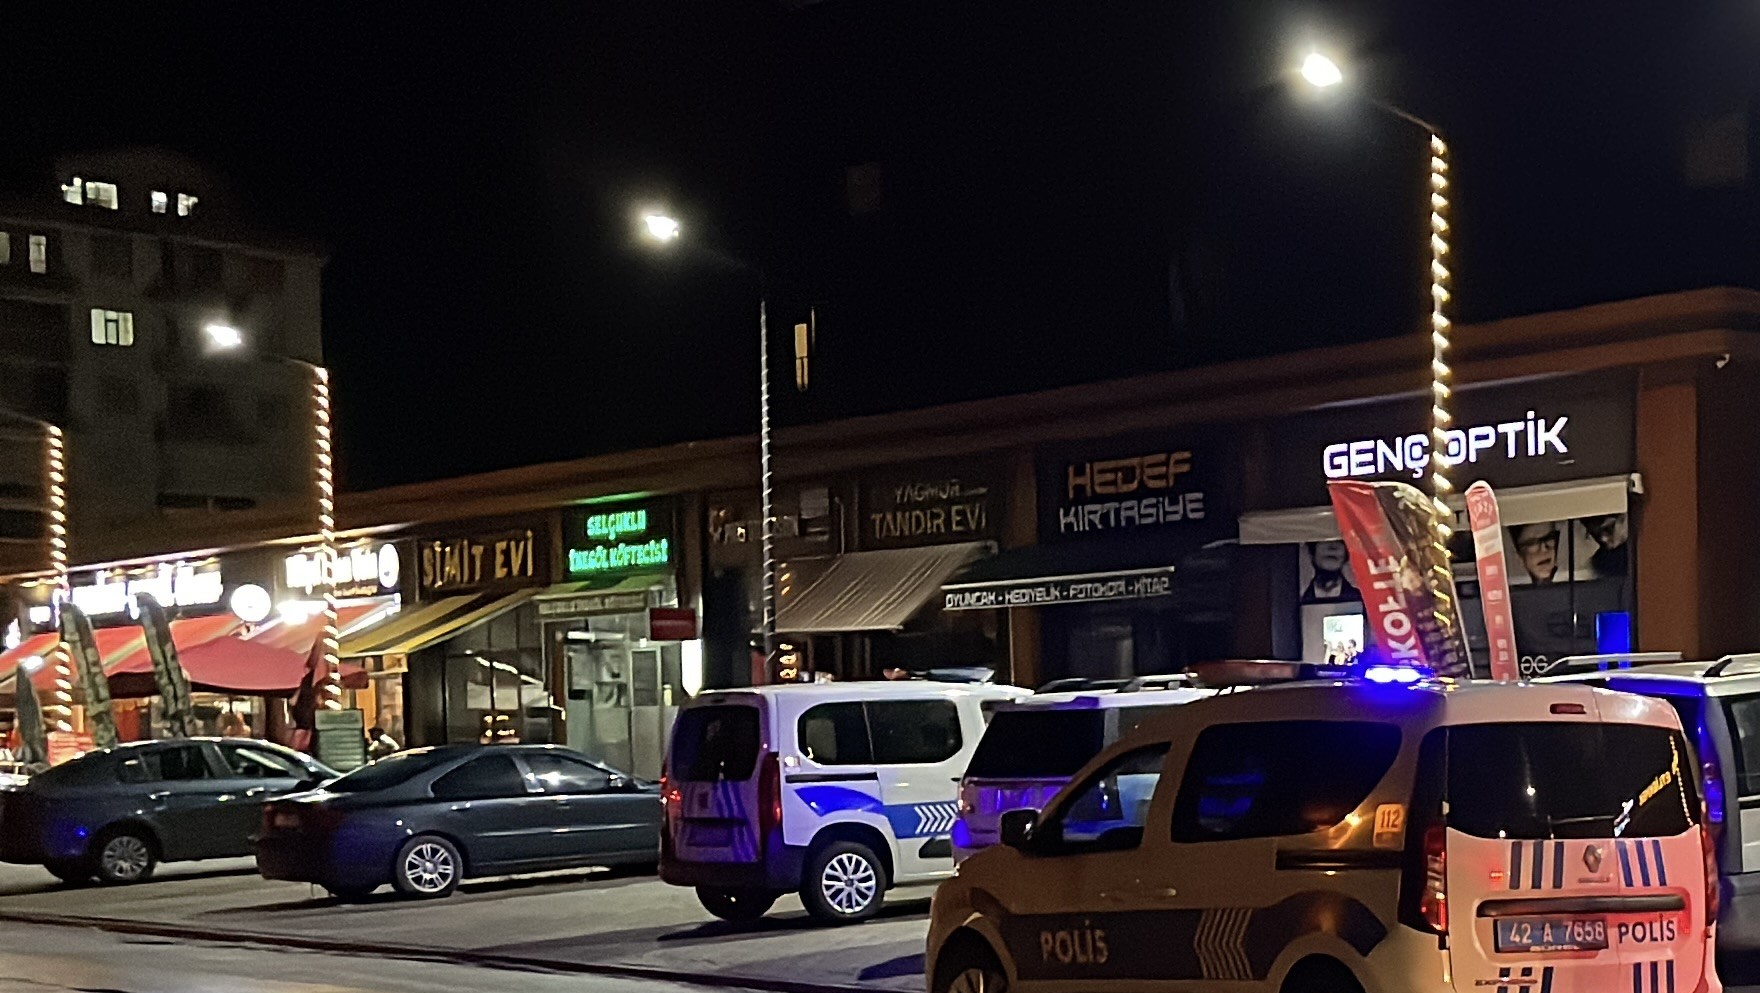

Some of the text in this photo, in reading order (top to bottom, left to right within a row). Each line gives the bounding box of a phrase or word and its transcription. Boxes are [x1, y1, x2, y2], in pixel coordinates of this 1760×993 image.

[1322, 410, 1569, 479] GENÇ OPTİK
[1067, 450, 1193, 499] HEDEF
[871, 507, 945, 540] TANDIR
[1058, 491, 1206, 534] KIRTASİYE
[422, 538, 484, 589] SİMİT
[494, 529, 534, 580] EVİ
[1380, 808, 1401, 828] 112
[1039, 919, 1109, 965] POLİS
[1509, 922, 1533, 945] 42
[1543, 922, 1553, 944] A
[1617, 913, 1676, 945] POLİS
